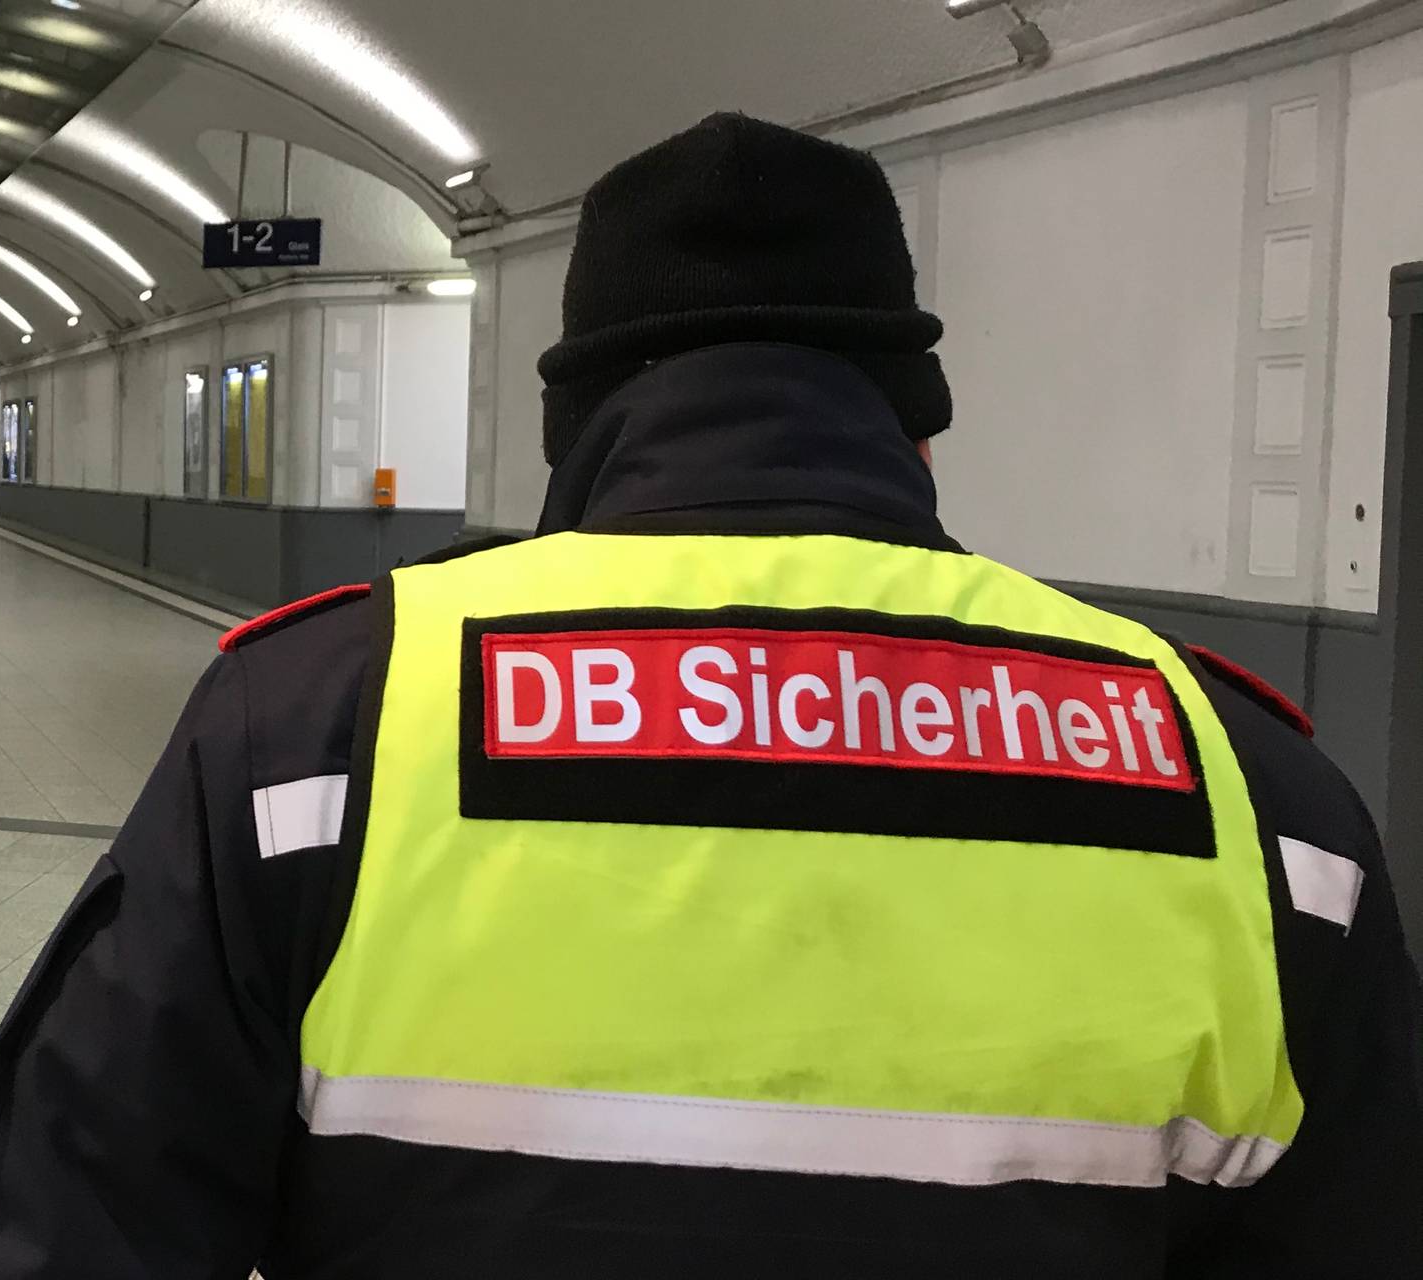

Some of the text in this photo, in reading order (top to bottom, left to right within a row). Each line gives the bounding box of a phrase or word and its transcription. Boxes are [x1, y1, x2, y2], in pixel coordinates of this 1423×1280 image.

[227, 222, 274, 252] 1-2
[495, 646, 1179, 776] DB Sicherheit
